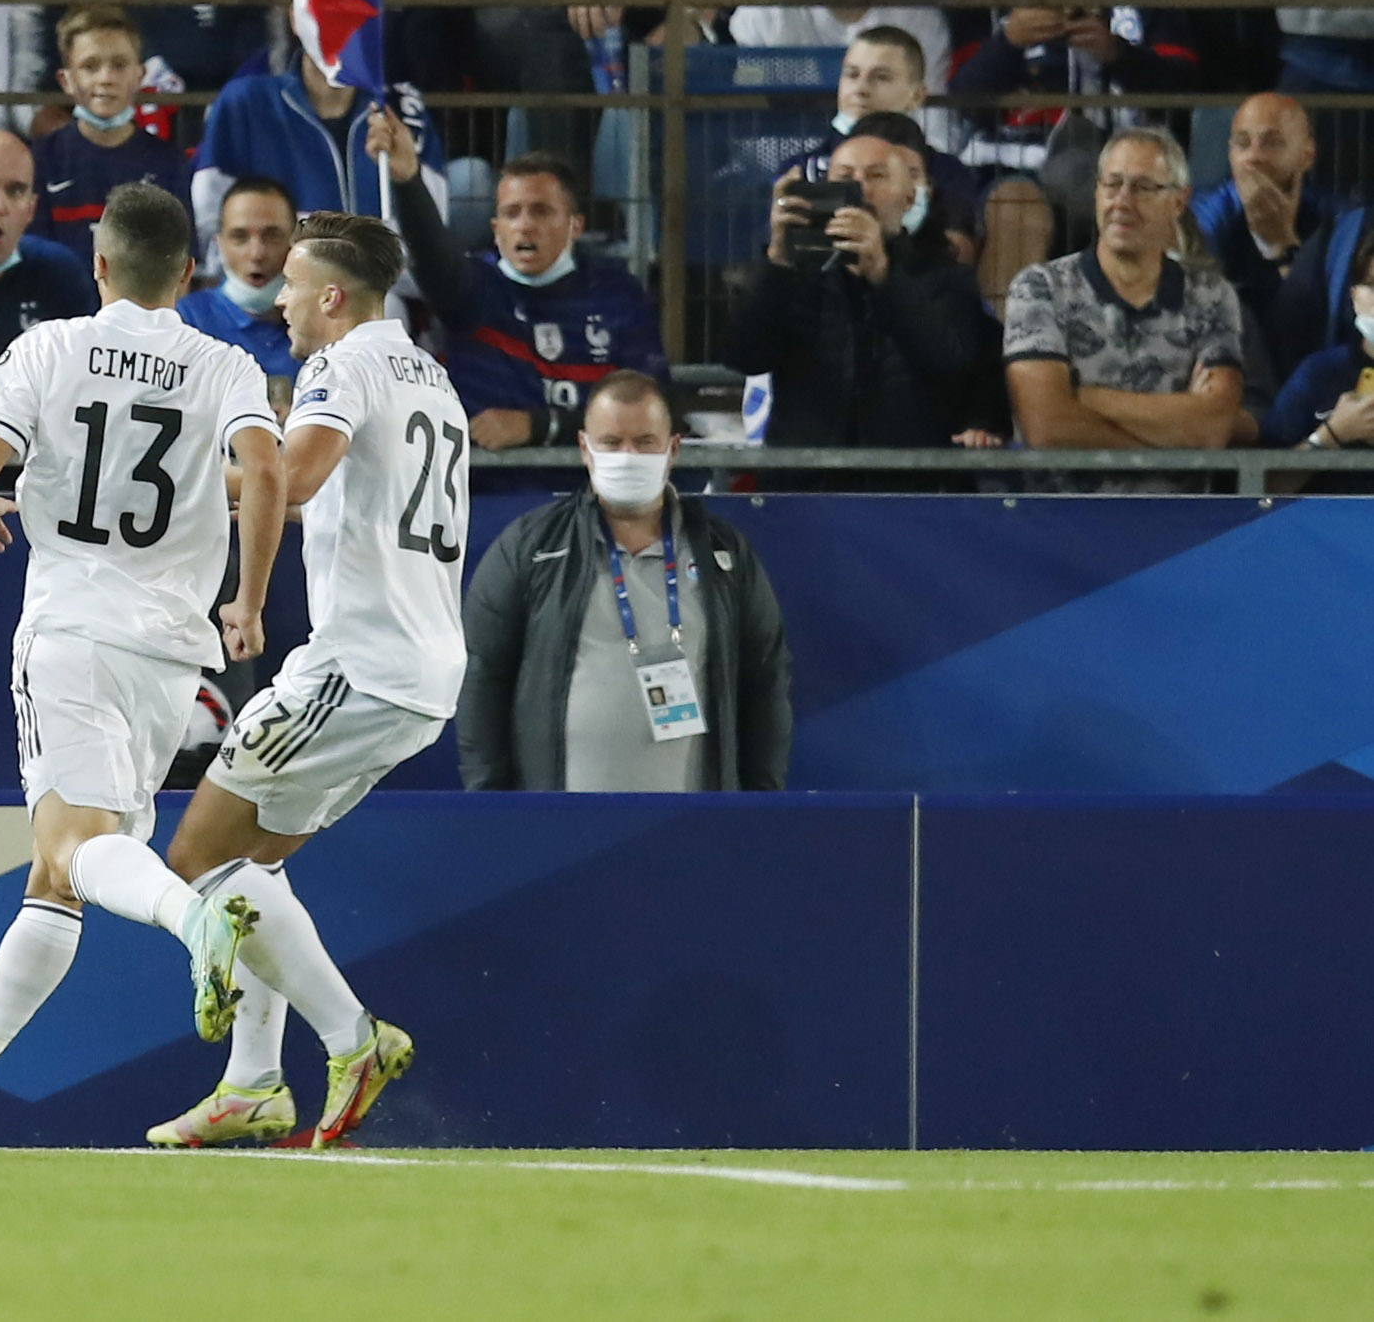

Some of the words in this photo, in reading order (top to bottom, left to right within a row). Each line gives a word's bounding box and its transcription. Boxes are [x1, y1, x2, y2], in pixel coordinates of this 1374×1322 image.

[88, 346, 189, 391] CIMIROT
[57, 401, 183, 548] 13
[397, 410, 464, 563] 23
